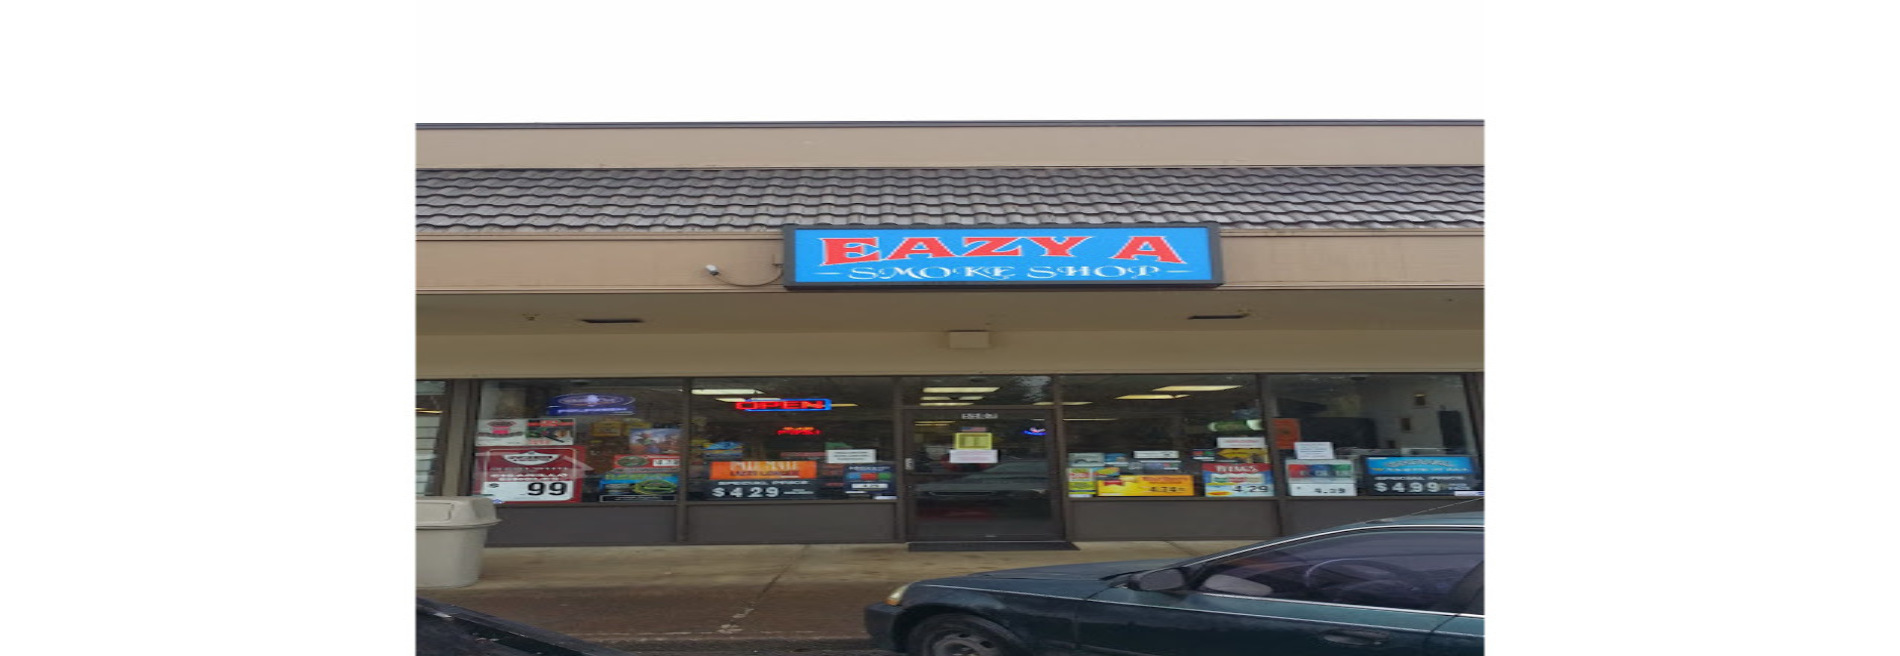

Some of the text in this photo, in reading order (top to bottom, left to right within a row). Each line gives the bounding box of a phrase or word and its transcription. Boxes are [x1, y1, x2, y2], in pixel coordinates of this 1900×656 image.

[820, 235, 1187, 266] EAZY A
[847, 265, 1160, 281] SMOKE SHOP
[735, 401, 825, 410] OPEN
[527, 482, 567, 496] 99
[711, 487, 780, 498] $429
[1374, 482, 1440, 493] $499
